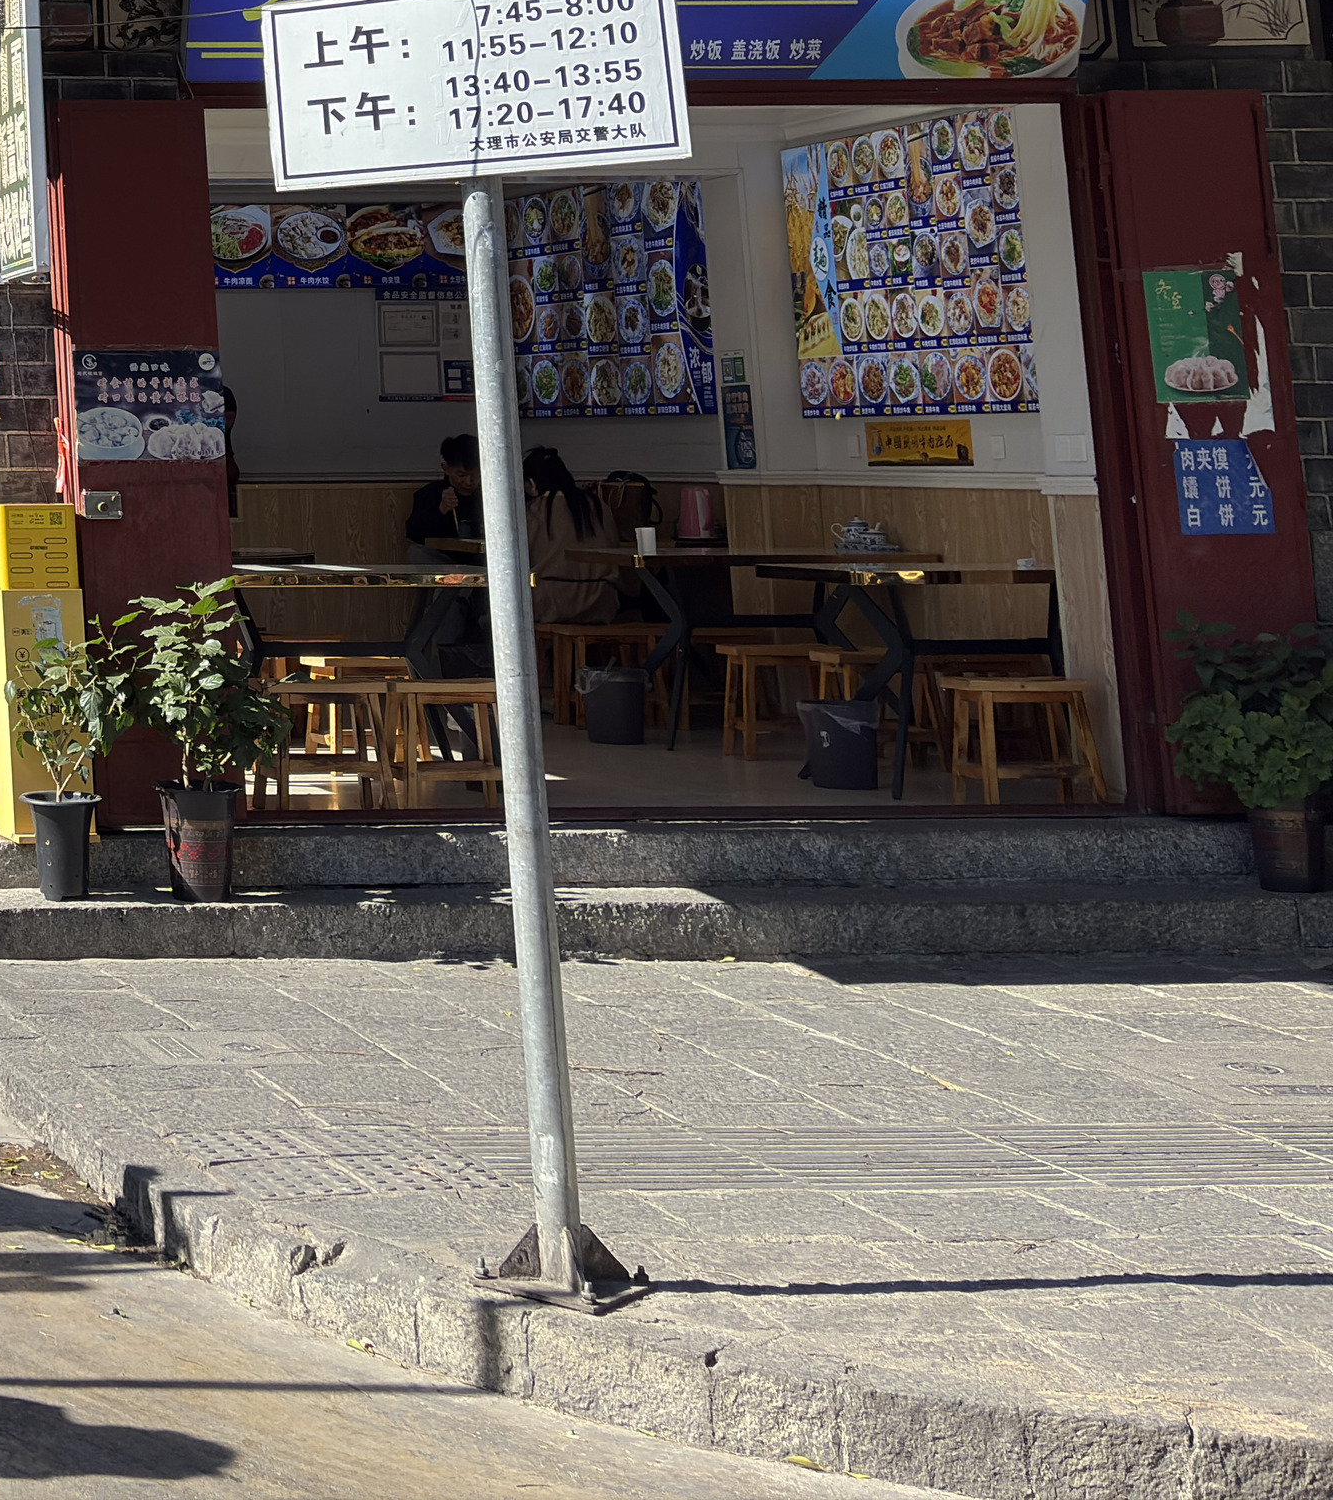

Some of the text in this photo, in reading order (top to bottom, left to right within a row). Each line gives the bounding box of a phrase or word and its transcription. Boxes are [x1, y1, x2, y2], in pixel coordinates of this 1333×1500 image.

[441, 21, 639, 63] 11:55-12:10
[689, 39, 823, 61] 炒饭 盖浇饭 炒菜
[445, 58, 643, 98] 13:40-13:55
[448, 91, 647, 131] 17:20-17:40
[469, 122, 647, 153] 大理市公安局交警大队
[1180, 447, 1229, 472] 肉夹馍
[1249, 476, 1266, 498] 元
[1187, 504, 1269, 527] 白饼 元
